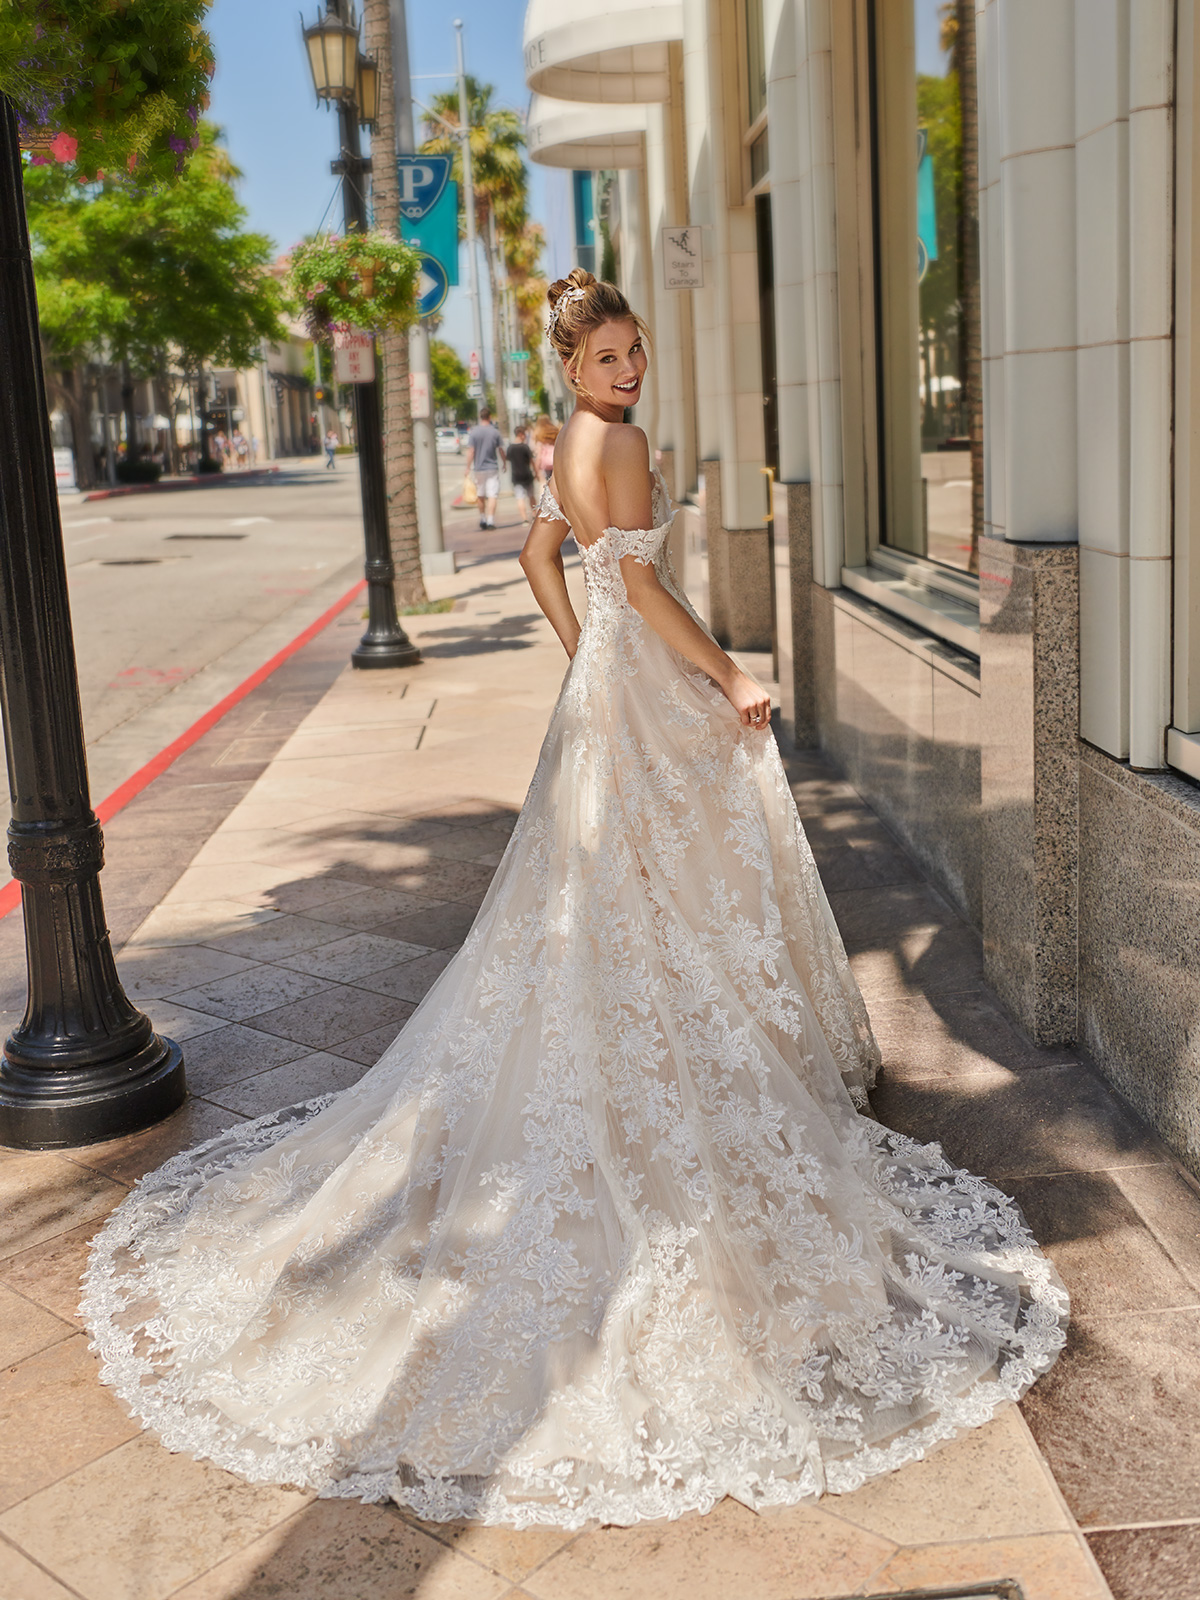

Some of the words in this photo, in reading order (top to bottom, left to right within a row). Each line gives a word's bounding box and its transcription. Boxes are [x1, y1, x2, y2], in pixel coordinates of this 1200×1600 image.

[399, 165, 434, 202] P
[671, 261, 695, 269] Stairs
[679, 269, 689, 277] To
[669, 278, 699, 286] Garage
[349, 352, 359, 361] ANY
